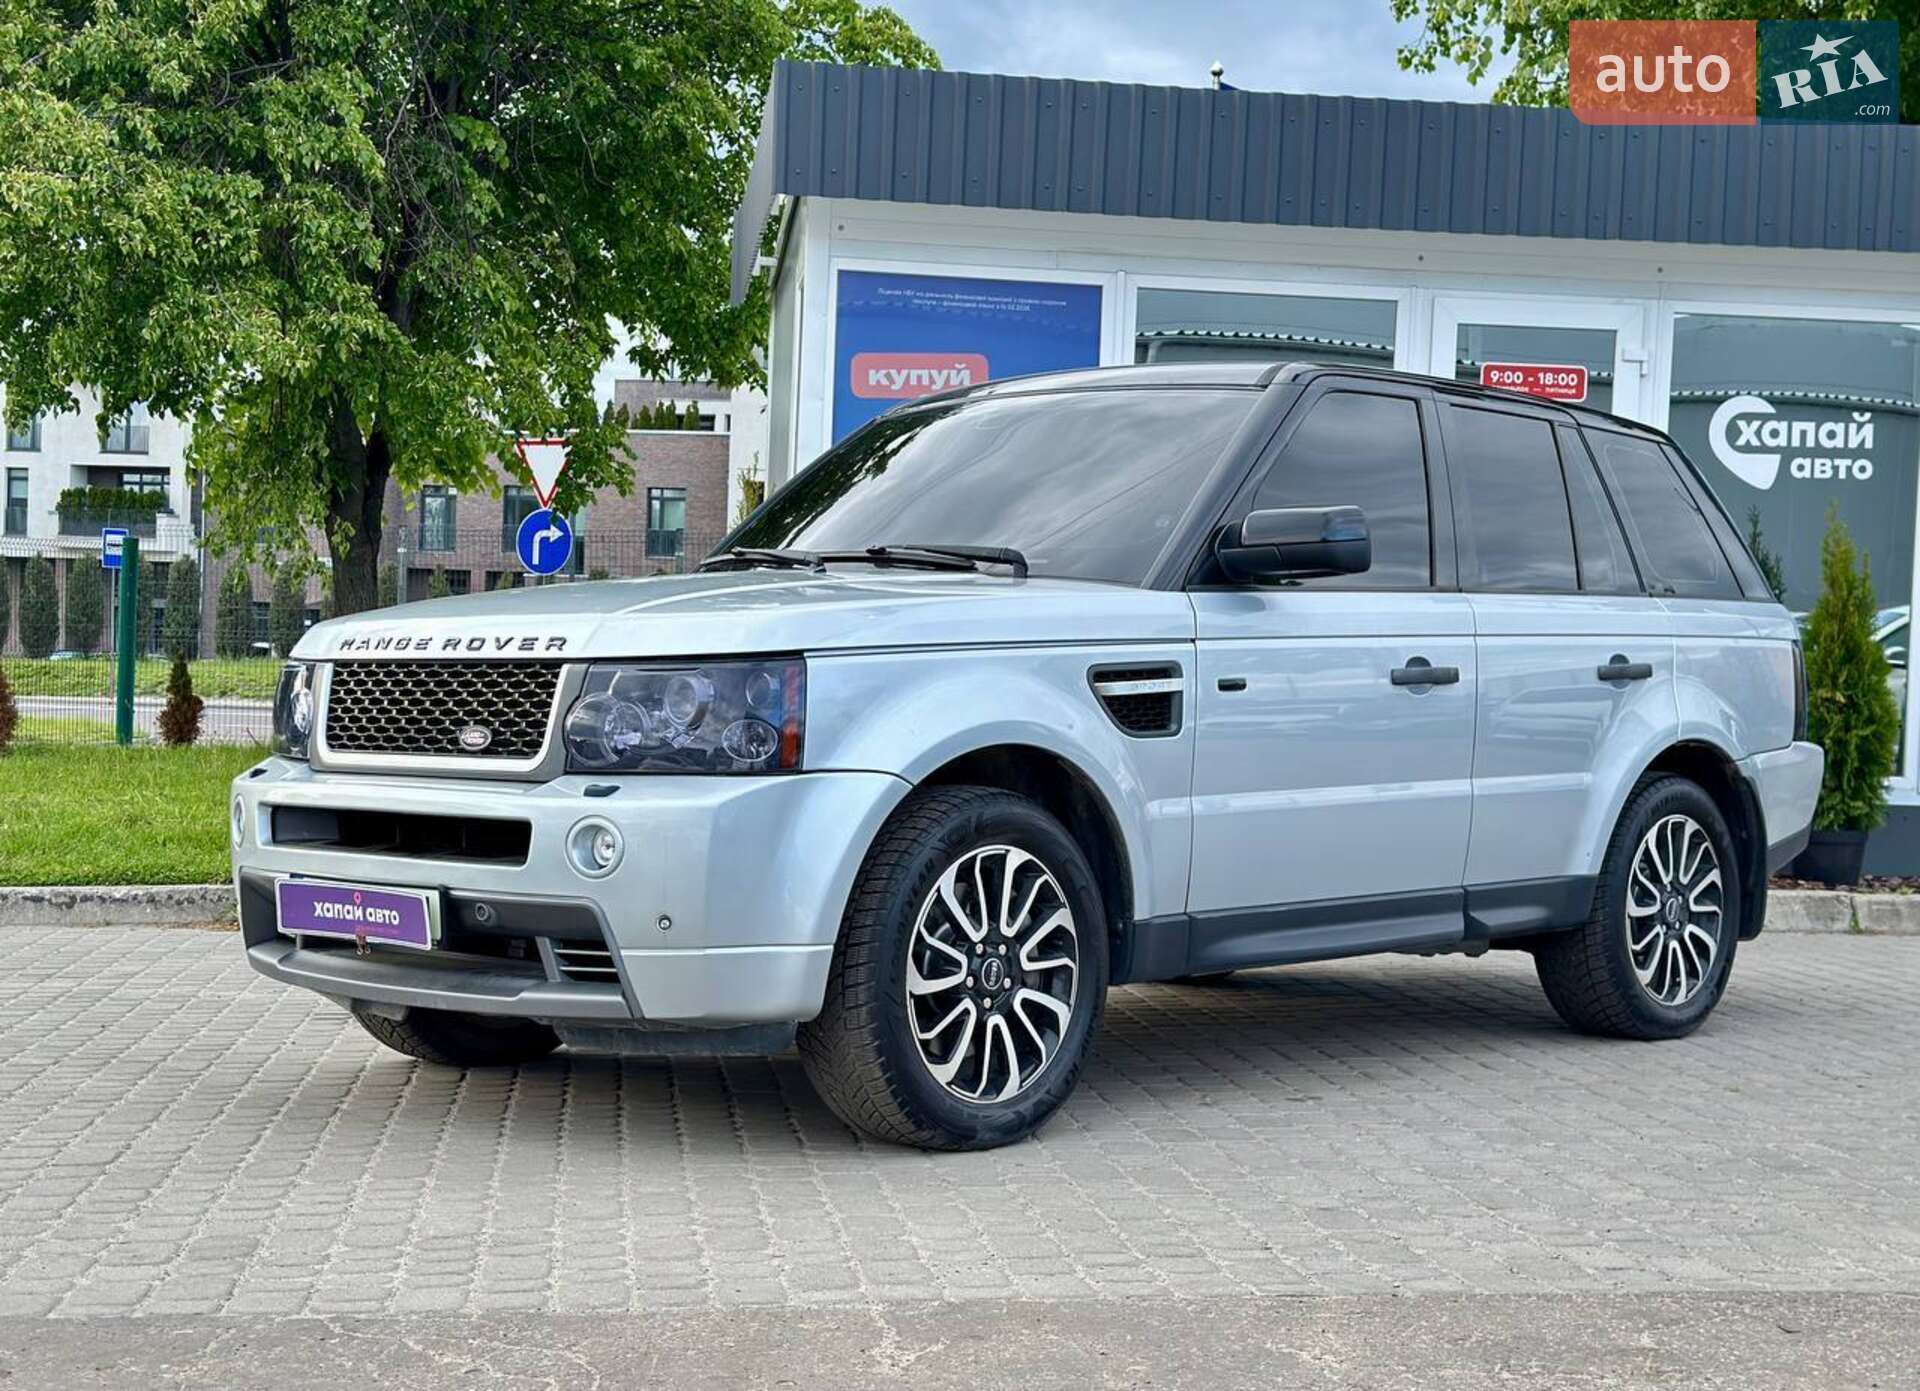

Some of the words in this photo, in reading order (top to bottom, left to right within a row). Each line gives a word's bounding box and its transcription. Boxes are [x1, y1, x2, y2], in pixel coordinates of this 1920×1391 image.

[868, 363, 971, 390] купуй
[1490, 370, 1523, 383] 9:00
[1537, 372, 1578, 386] 18:00
[1735, 411, 1875, 449] хапай
[1790, 457, 1873, 480] авто
[339, 636, 433, 651] RANGE
[441, 636, 568, 651] ROVER
[366, 907, 400, 925] авто
